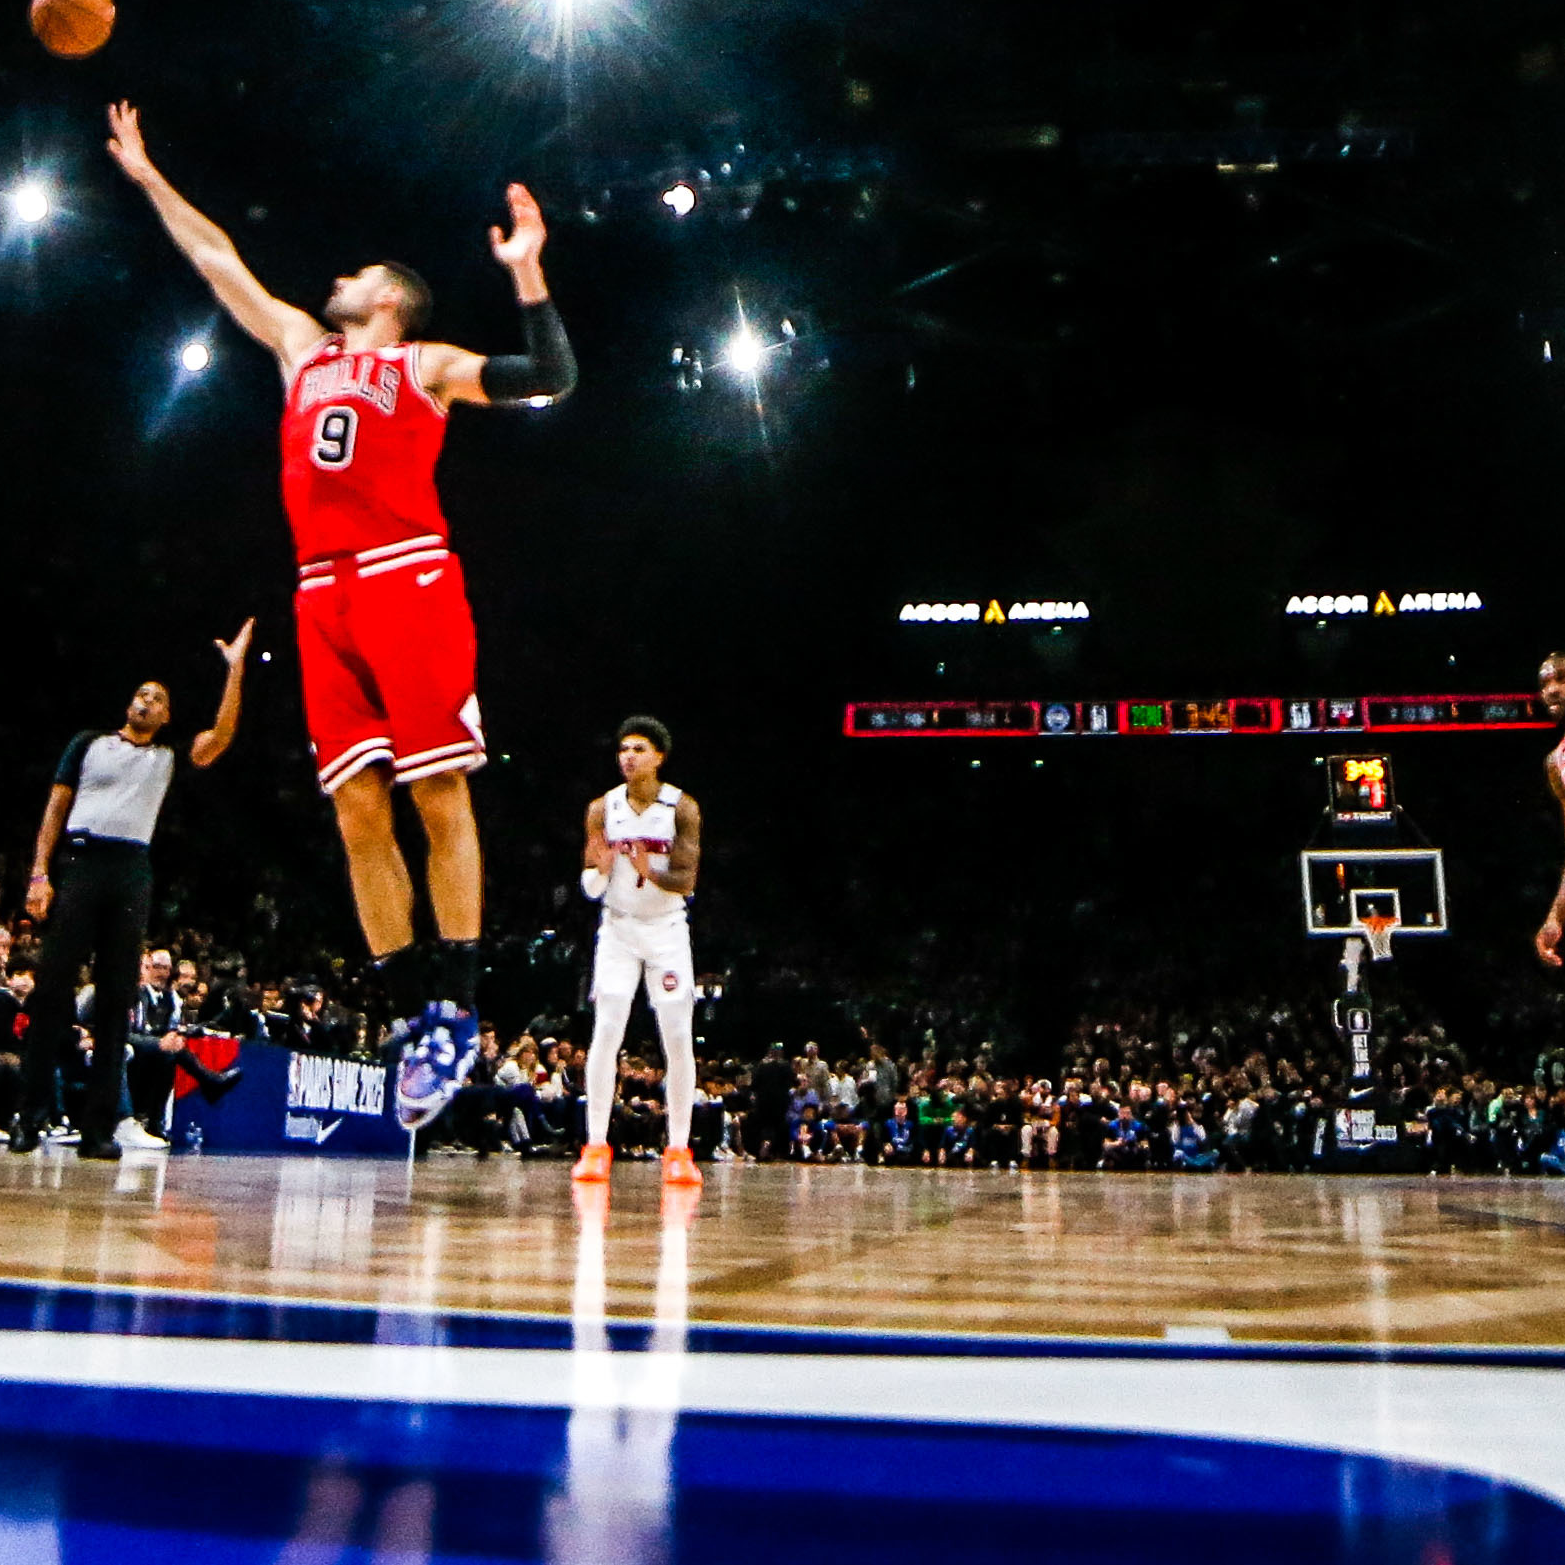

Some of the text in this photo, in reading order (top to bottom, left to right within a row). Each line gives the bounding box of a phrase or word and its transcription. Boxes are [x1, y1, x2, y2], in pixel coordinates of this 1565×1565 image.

[299, 355, 402, 415] BULLS
[311, 405, 359, 472] 9
[899, 603, 981, 622] ACCOR
[1008, 601, 1090, 620] ARENA
[1285, 595, 1369, 614] ACCOR
[1398, 592, 1483, 612] ARENA
[299, 1053, 333, 1109] PARIS
